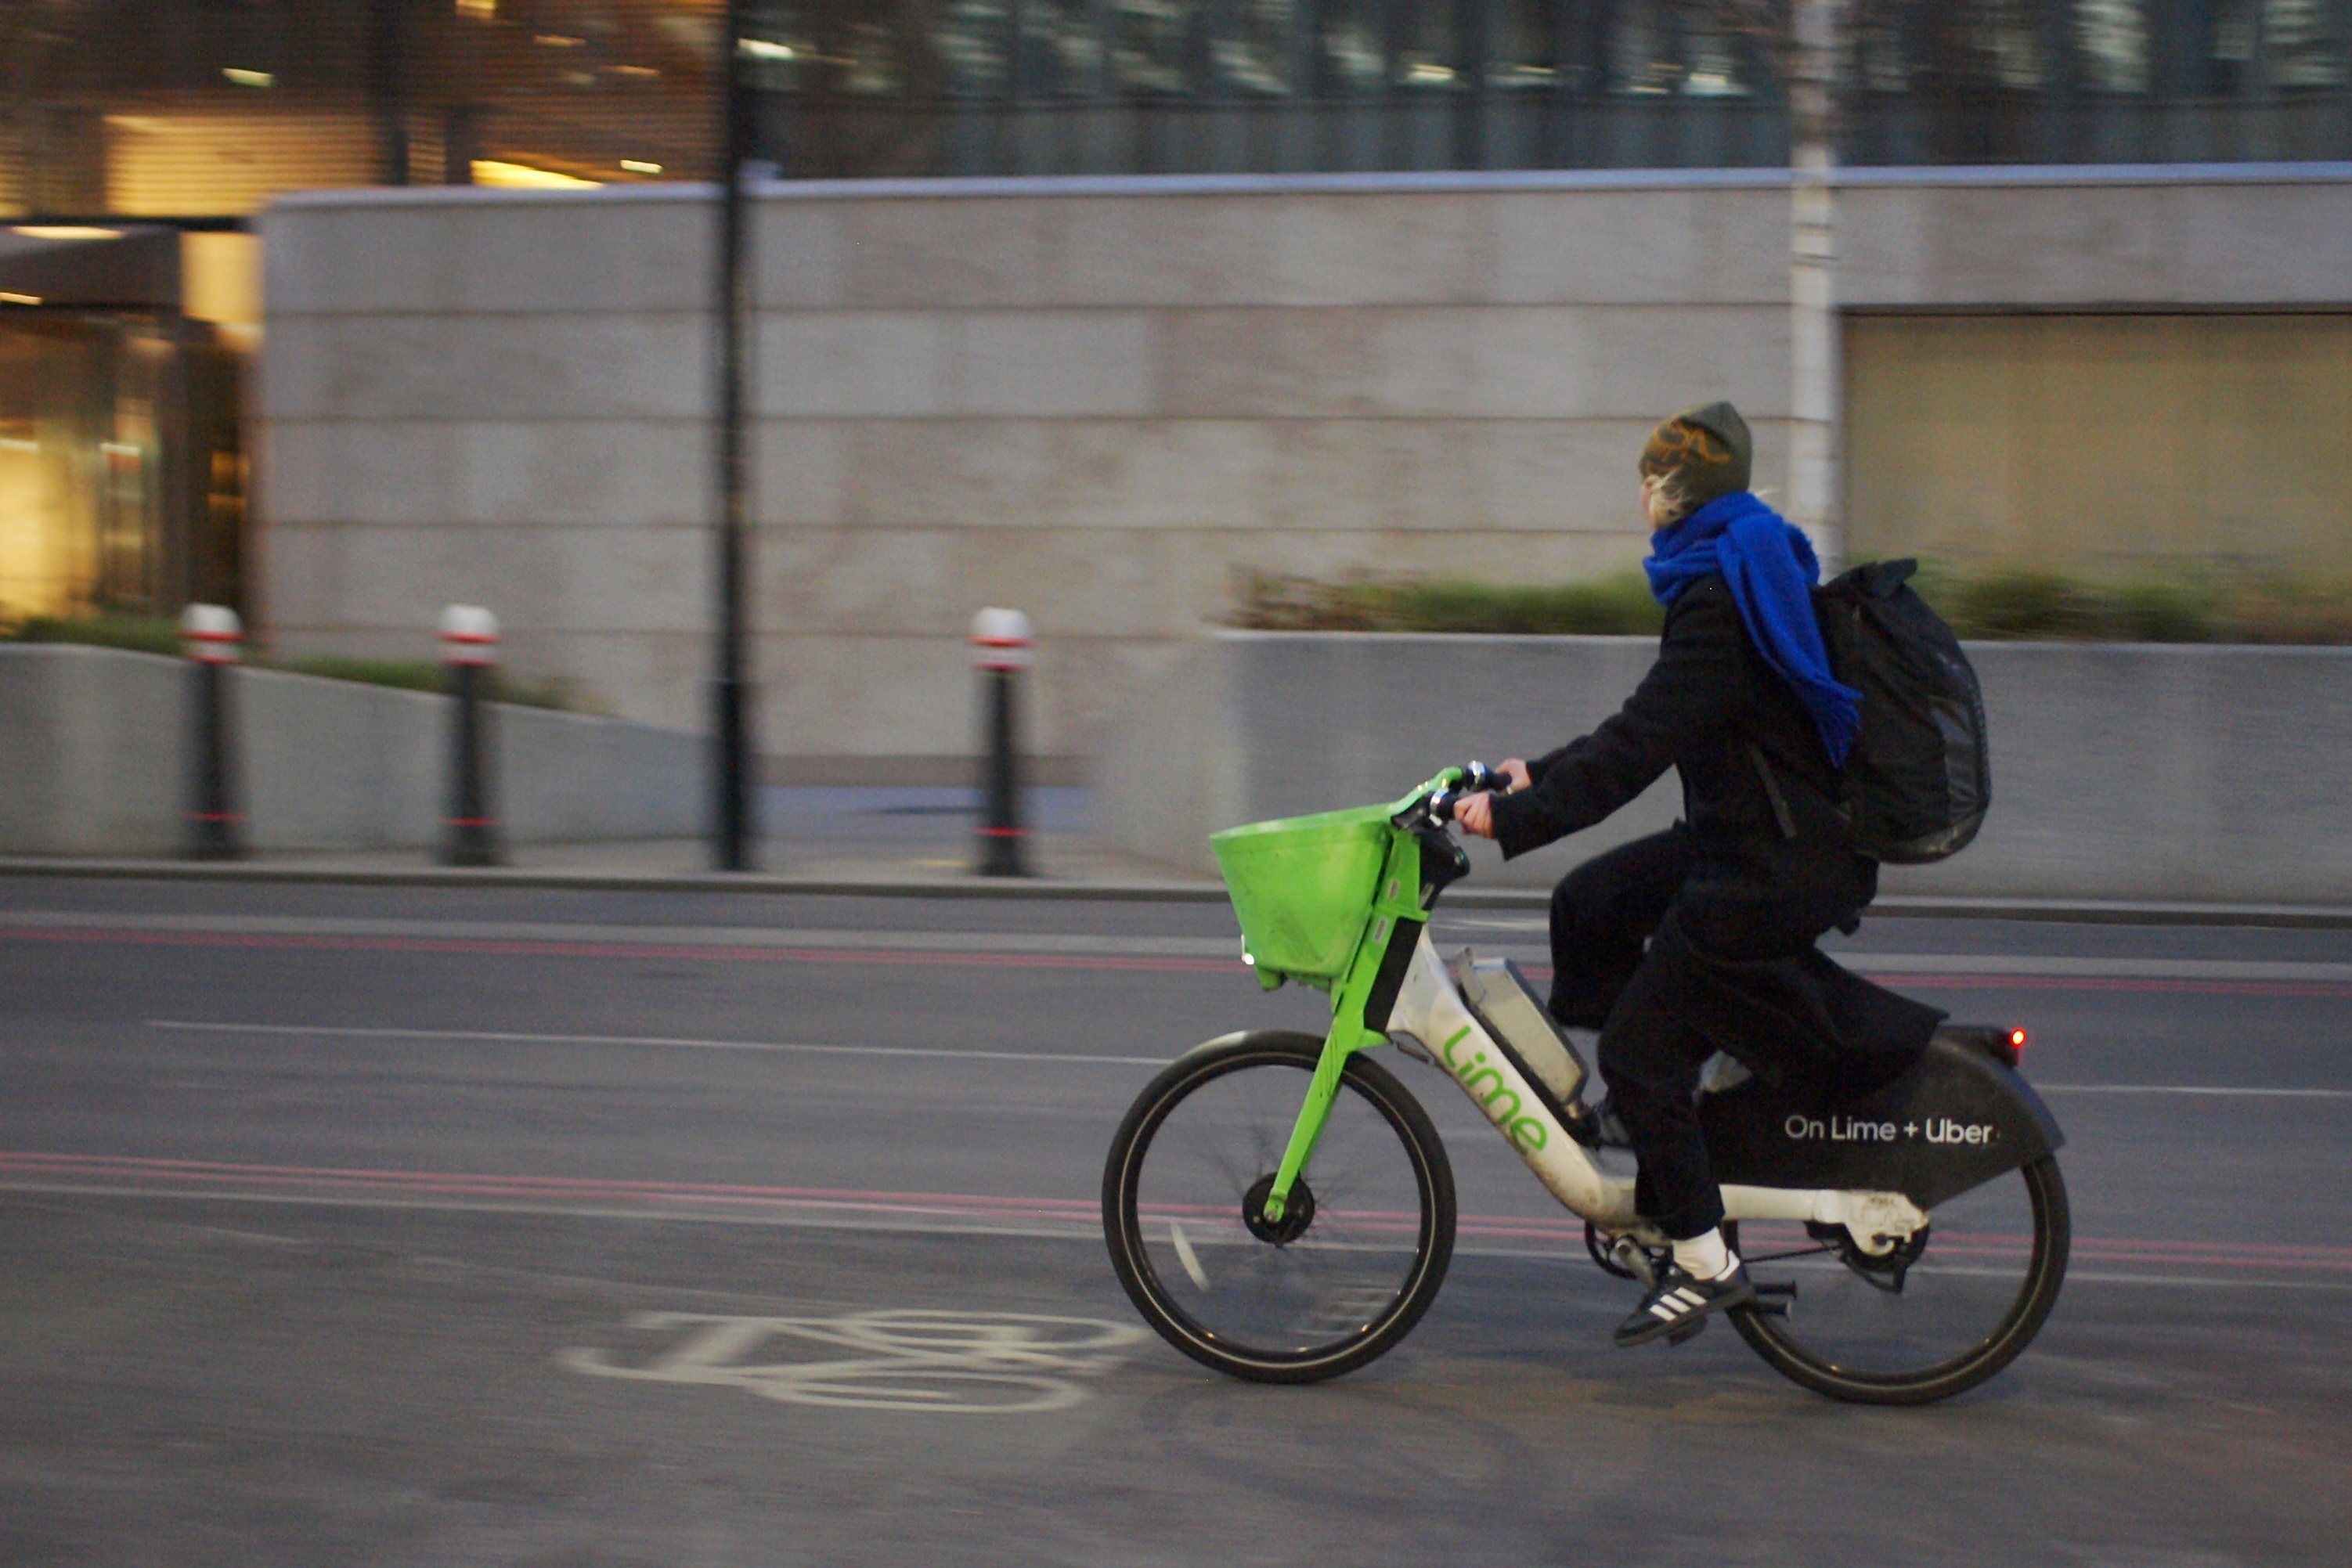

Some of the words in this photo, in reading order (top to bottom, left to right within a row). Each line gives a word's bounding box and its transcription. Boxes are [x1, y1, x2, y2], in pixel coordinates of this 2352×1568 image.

[1444, 1025, 1547, 1154] Lime
[1784, 1114, 1825, 1140] On
[1831, 1115, 1896, 1142] Lime
[1903, 1120, 1918, 1138] +
[1925, 1117, 1993, 1144] Uber
